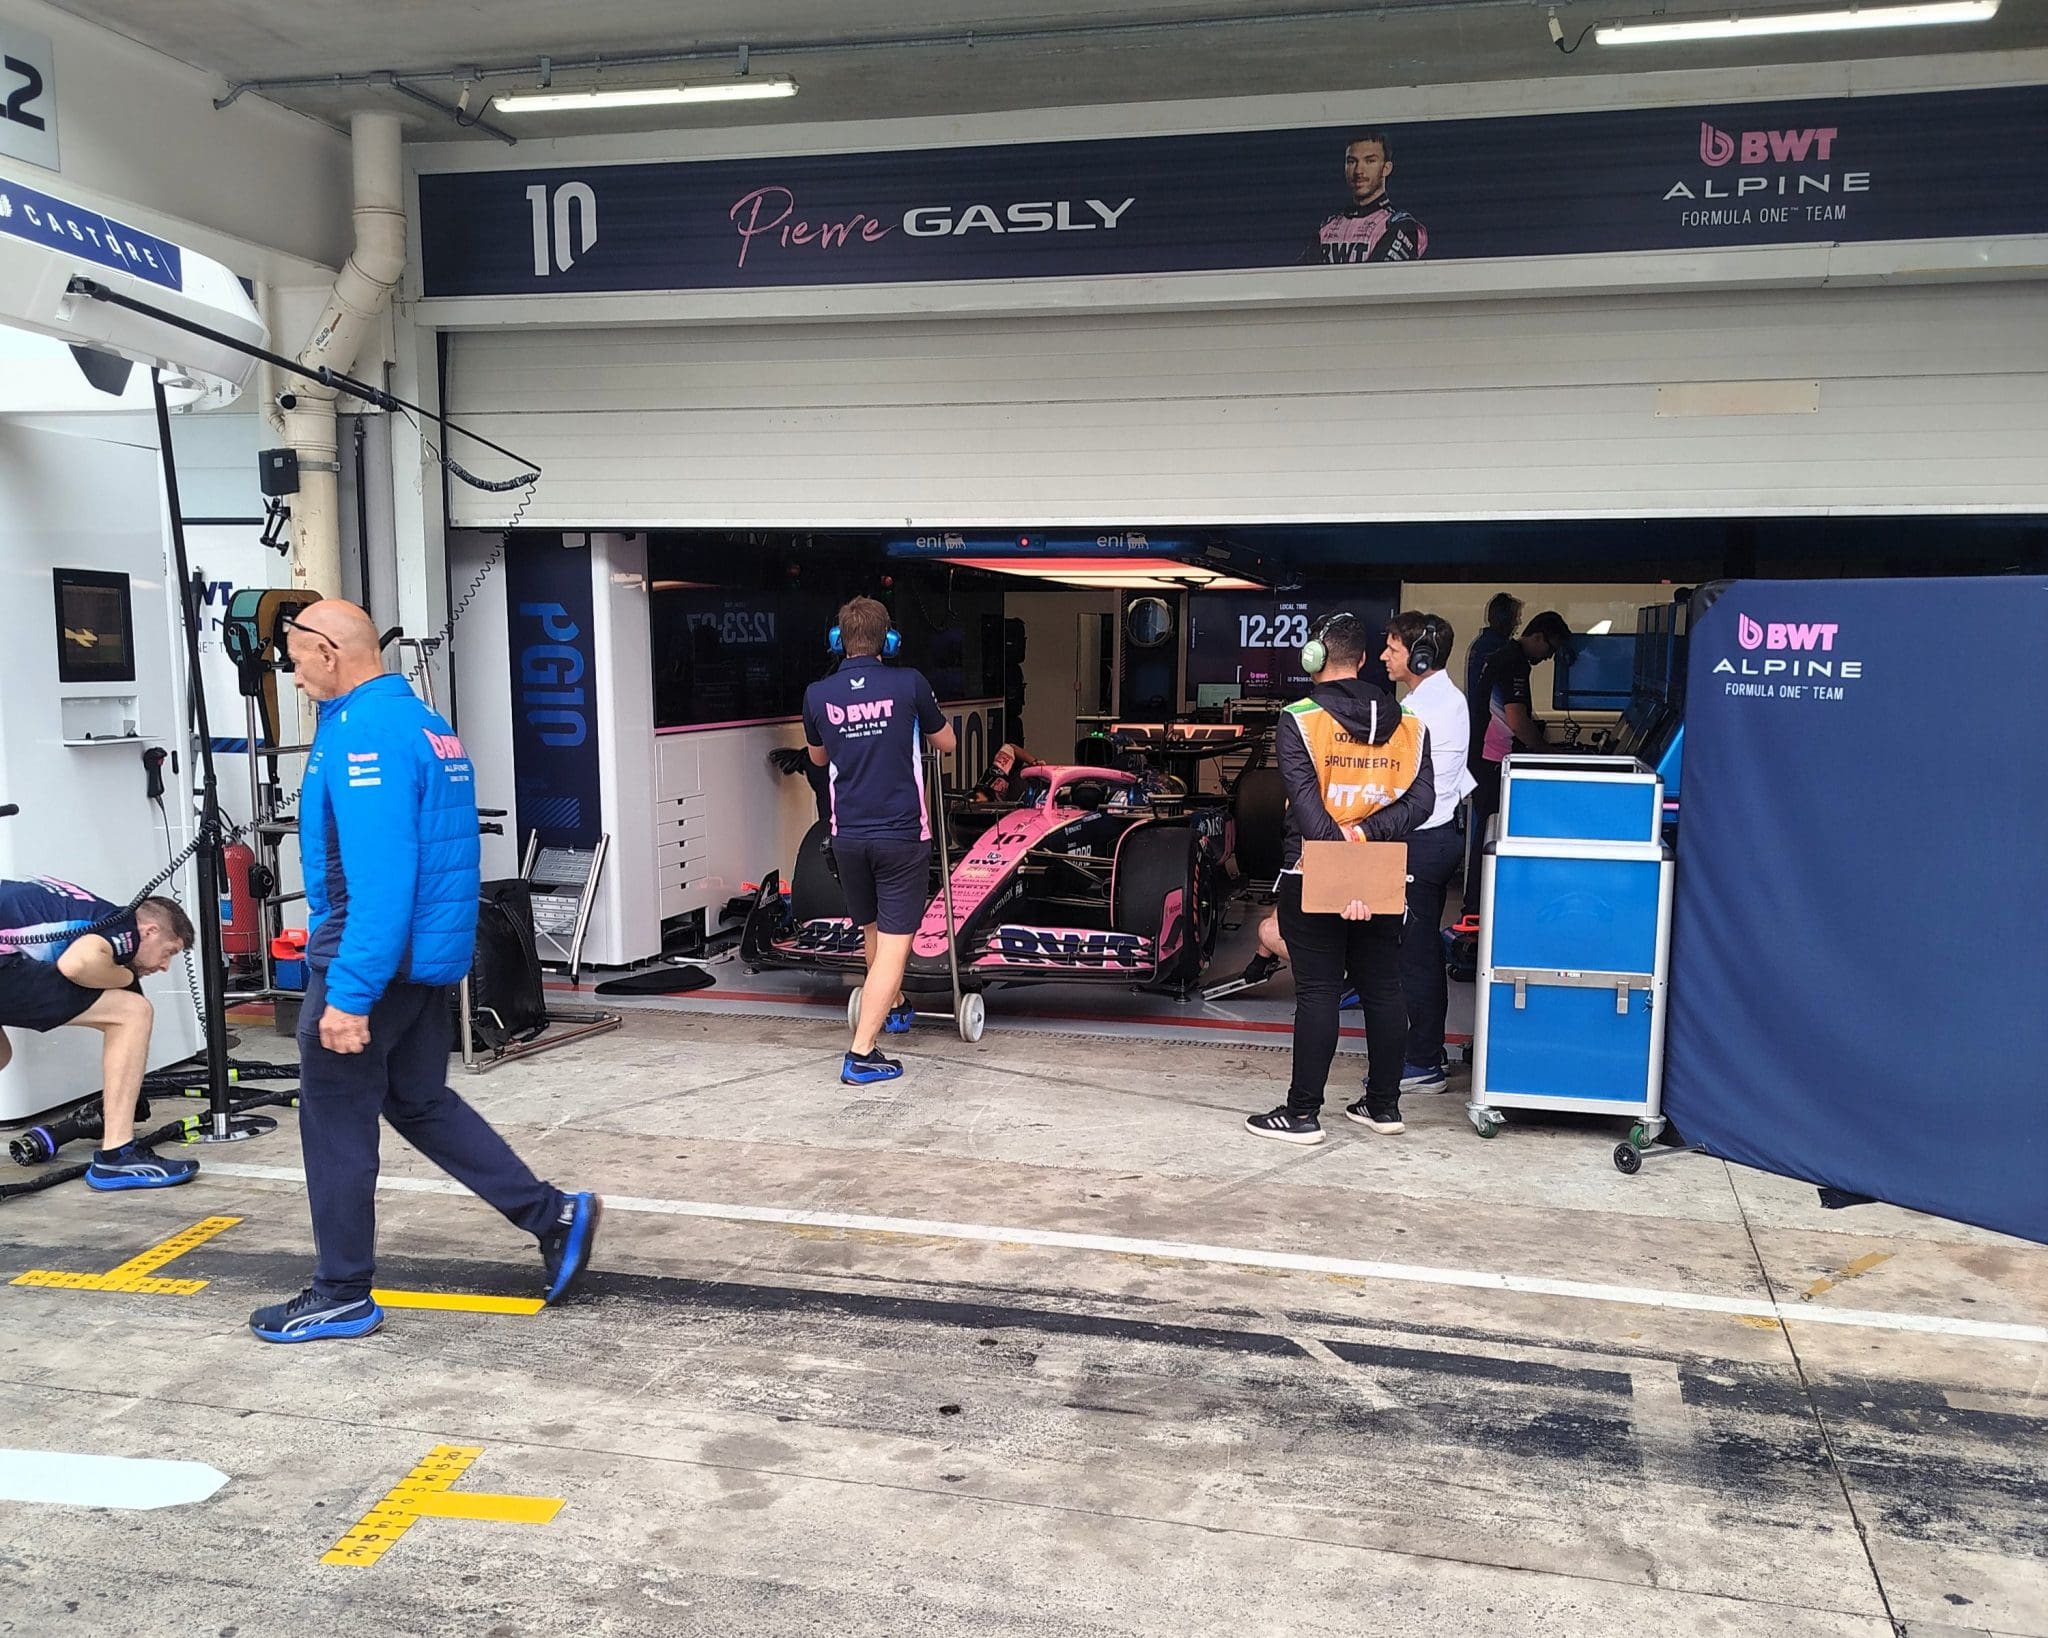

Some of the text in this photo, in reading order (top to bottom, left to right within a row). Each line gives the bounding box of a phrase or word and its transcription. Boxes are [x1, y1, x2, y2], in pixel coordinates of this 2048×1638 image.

[1740, 127, 1838, 165] BWT
[1662, 172, 1871, 201] ALPINE
[730, 185, 1136, 268] Pierre GASLY
[1681, 208, 1752, 227] FORMULA
[1805, 204, 1847, 222] TEAM
[23, 203, 159, 269] CASTORE
[526, 181, 597, 276] 10
[916, 533, 942, 548] eni
[1097, 532, 1123, 548] eni
[1766, 623, 1838, 650] BWT
[1712, 657, 1862, 678] ALPINE
[1725, 682, 1774, 697] FORMULA
[1813, 686, 1844, 700] TEAM
[846, 699, 894, 722] BWT
[838, 720, 888, 734] ALPINE
[991, 831, 1027, 846] 10
